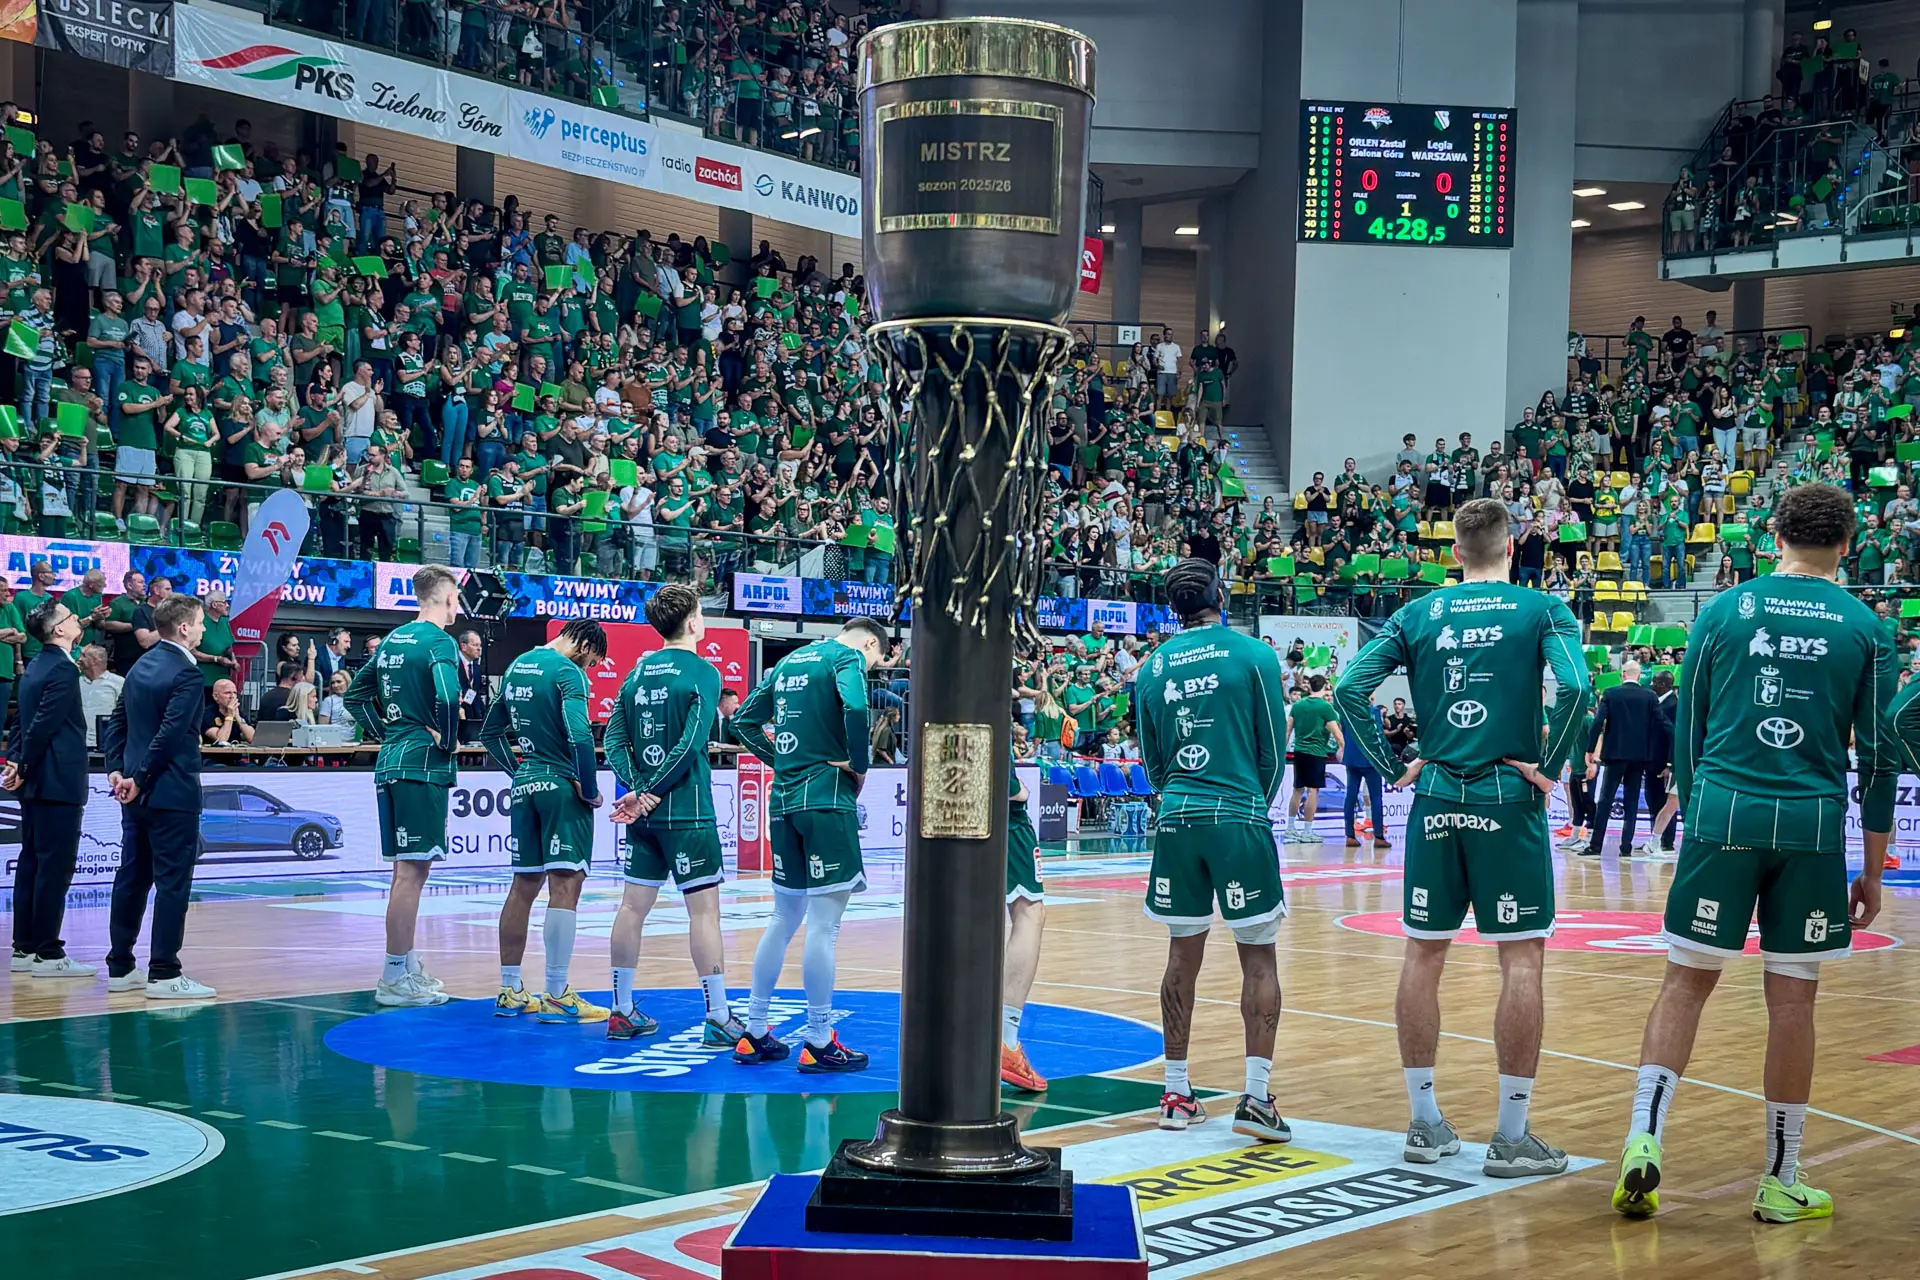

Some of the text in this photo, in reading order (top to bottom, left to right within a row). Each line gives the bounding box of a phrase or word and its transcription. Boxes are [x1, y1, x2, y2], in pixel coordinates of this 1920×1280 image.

[64, 23, 146, 54] EKSPERT OPTYK
[294, 64, 355, 102] PKS
[364, 82, 503, 139] Zielona Góra
[1310, 116, 1343, 125] 0 0 0
[1310, 126, 1342, 135] 3 0 0
[1474, 123, 1506, 132] 0 0 0
[560, 118, 648, 157] perceptus
[1322, 137, 1329, 145] 0
[1336, 137, 1342, 145] 0
[1474, 133, 1506, 142] 1 0 0
[1349, 138, 1406, 149] ORLEN Zastal
[1427, 140, 1453, 151] Legia
[1486, 144, 1493, 152] 0
[1500, 144, 1506, 152] 0
[920, 142, 1011, 162] MISTRZ
[1309, 147, 1342, 156] 6 0 0
[1350, 148, 1404, 159] Zielona Góra
[1412, 151, 1468, 162] WARSZAWA
[561, 150, 638, 177] BEZPIECZEŃSTWO
[1309, 157, 1342, 166] 7 0 0
[1486, 154, 1493, 162] 0
[1499, 154, 1505, 162] 0
[661, 157, 740, 186] radio zachód
[1322, 168, 1328, 176] 0
[1335, 168, 1341, 177] 0
[1473, 164, 1505, 173] 7 0 0
[1321, 178, 1328, 187] 0
[1335, 179, 1341, 187] 0
[1362, 169, 1378, 191] 0
[1436, 173, 1452, 193] 0
[1485, 174, 1492, 183] 0
[1499, 175, 1505, 183] 0
[1306, 188, 1341, 197] 12 0 0
[1485, 185, 1492, 193] 0
[1499, 185, 1505, 193] 0
[780, 179, 859, 217] KANWOD
[1321, 199, 1327, 207] 0
[1334, 200, 1340, 208] 0
[1485, 195, 1491, 203] 0
[1498, 195, 1504, 203] 0
[1355, 200, 1367, 215] 0
[1401, 202, 1411, 216] 1
[1447, 204, 1459, 218] 0
[1485, 205, 1491, 213] 0
[1498, 205, 1504, 213] 0
[1321, 209, 1327, 218] 0
[1334, 210, 1340, 218] 0
[1320, 220, 1327, 228] 0
[1334, 220, 1340, 229] 0
[1484, 216, 1491, 224] 0
[1498, 216, 1504, 224] 0
[1304, 230, 1340, 239] 77 0 0
[1468, 225, 1504, 234] 42 0 0
[1122, 330, 1136, 341] F1
[553, 576, 620, 600] ŻYWIMY
[742, 584, 790, 601] ARPOL
[1450, 596, 1503, 606] TRAMWAJE
[1764, 597, 1826, 611] TRAMWAJE
[535, 600, 637, 622] BOHATERÓW
[1450, 603, 1518, 613] WARSZAWSKIE
[1093, 609, 1128, 623] ARPOL
[1764, 605, 1844, 623] WARSZAWSKIE
[237, 627, 261, 638] ORLEN
[1462, 624, 1504, 642] BYŚ
[1779, 635, 1829, 656] BYŚ
[1168, 644, 1216, 661] TRAMWAJE
[1779, 653, 1818, 662] RECYKLING
[1168, 650, 1230, 668] WARSZAWSKIE
[1184, 673, 1220, 694] BYŚ
[1424, 812, 1490, 833] pompax
[1692, 920, 1718, 931] ORLEN
